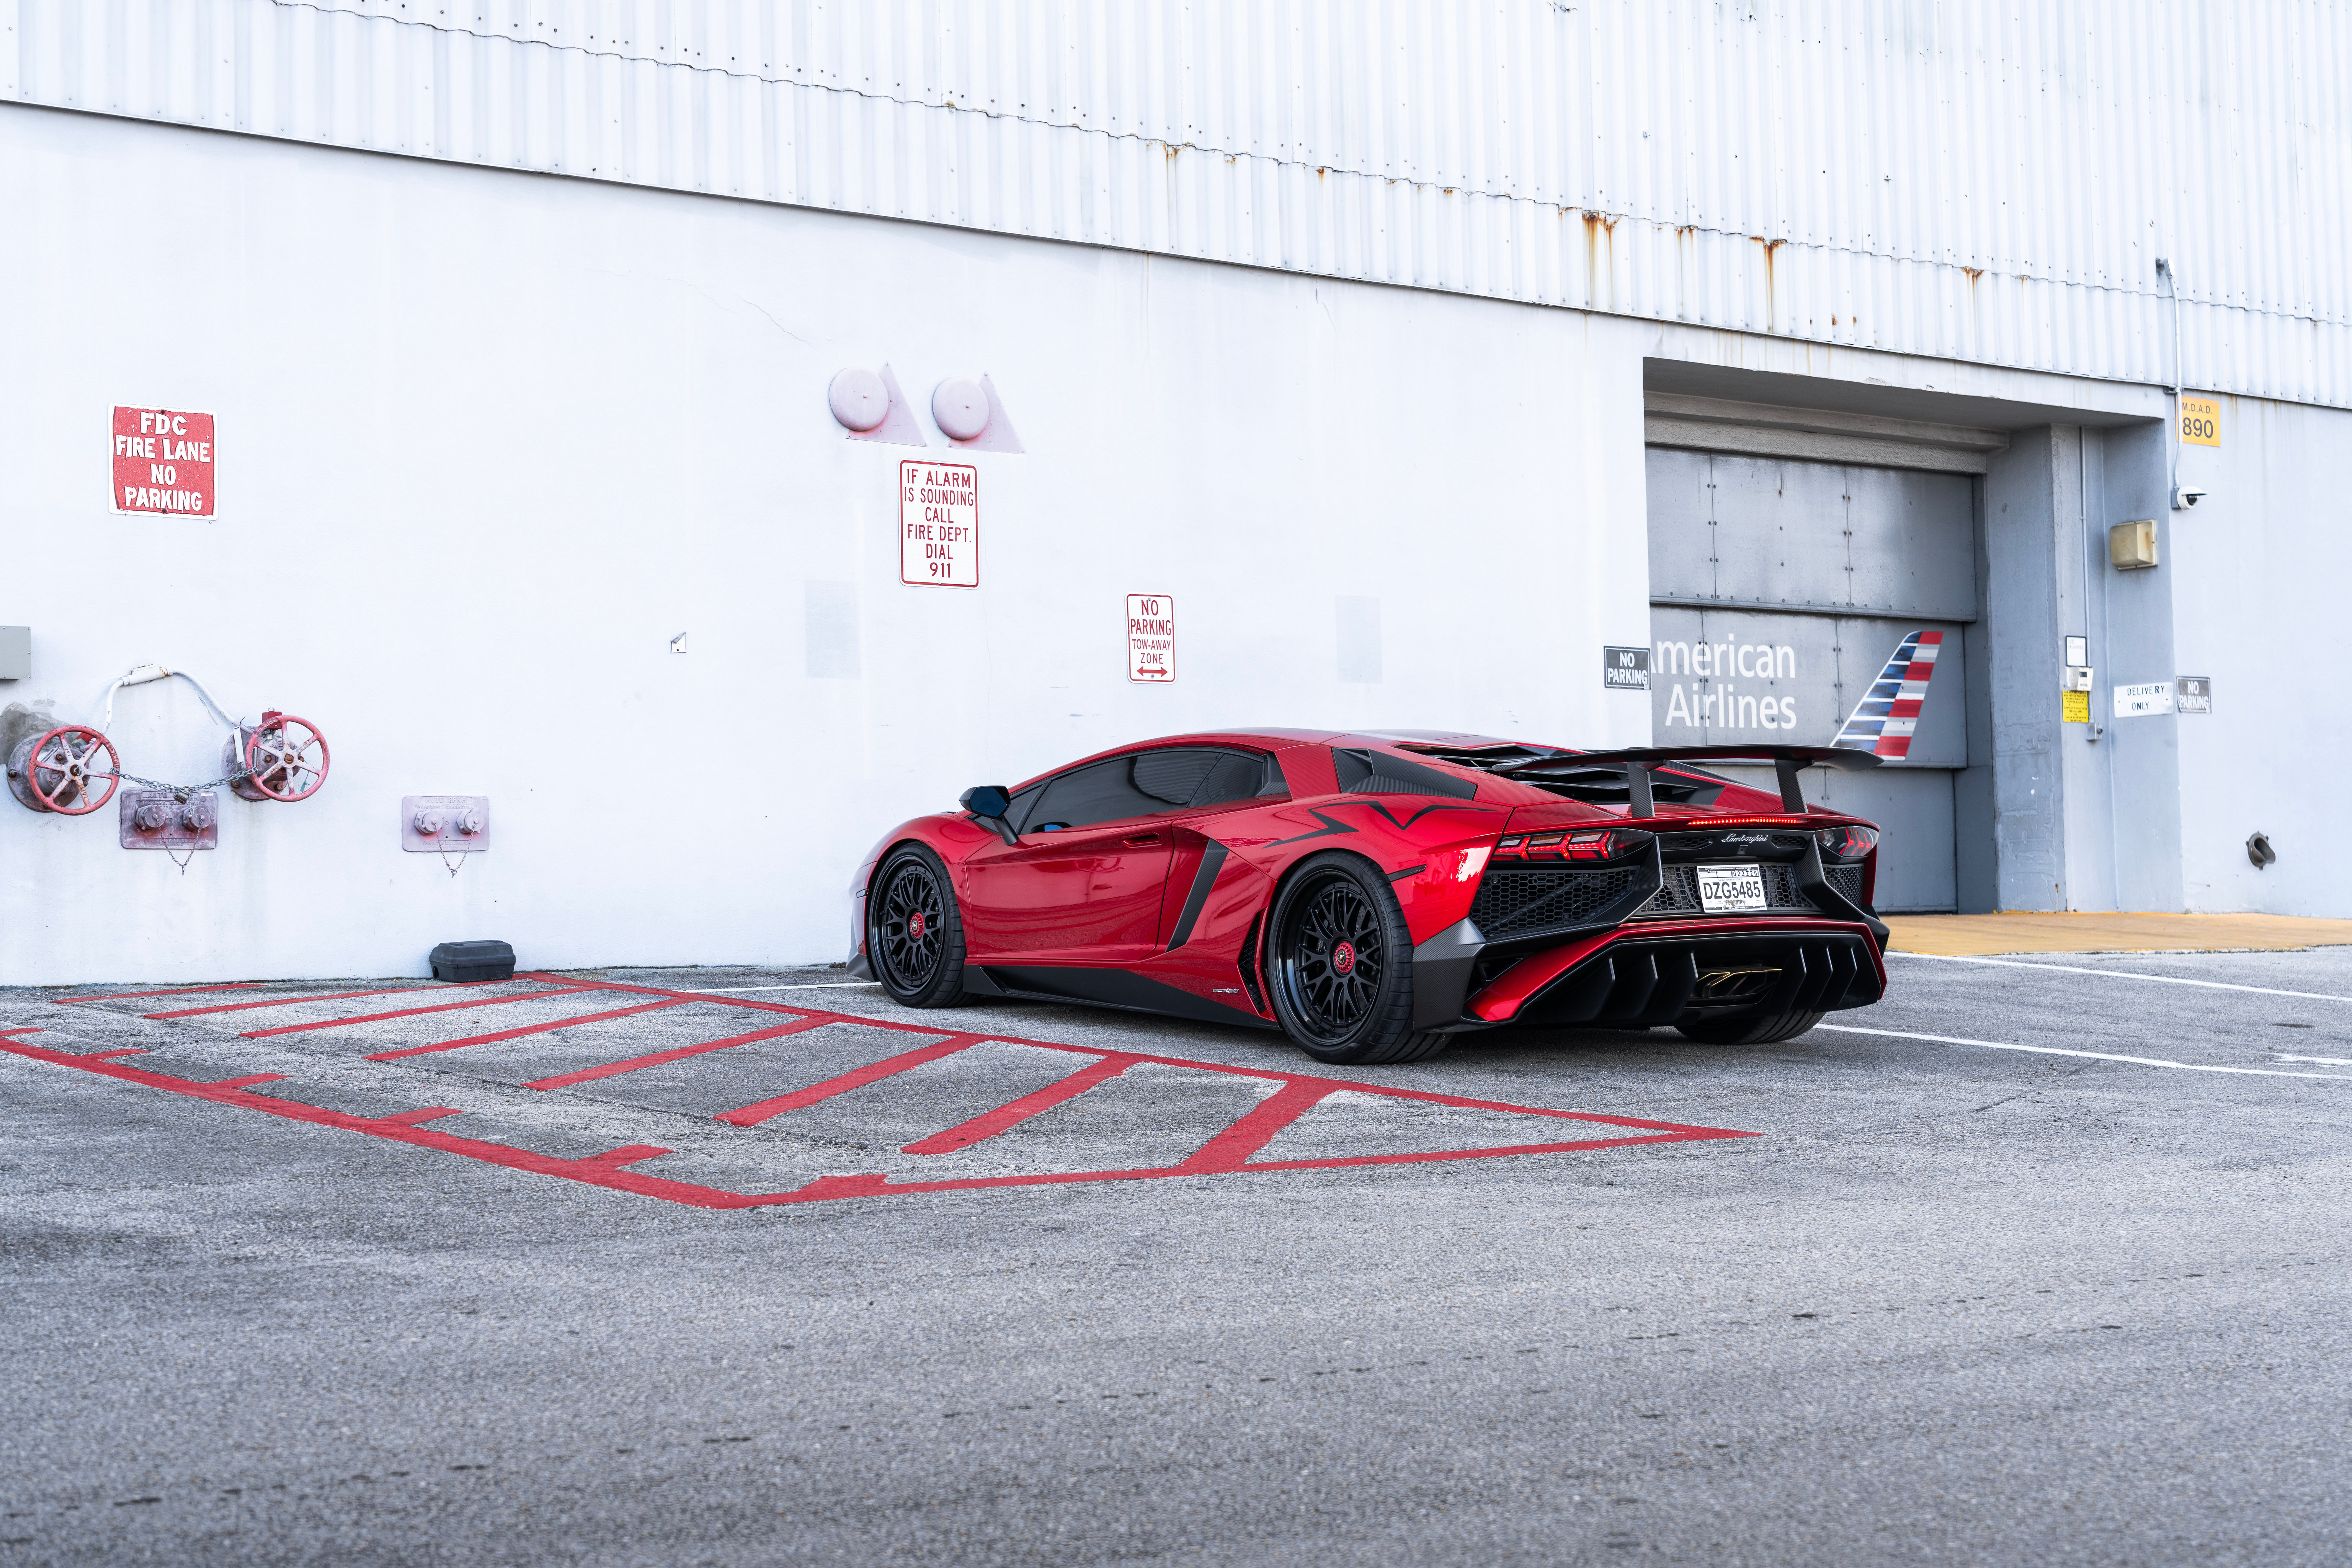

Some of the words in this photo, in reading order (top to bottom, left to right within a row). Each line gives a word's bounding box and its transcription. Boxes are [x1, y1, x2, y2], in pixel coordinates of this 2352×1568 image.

[2182, 402, 2213, 414] M.D.A.D.
[140, 411, 187, 436] FDC
[2183, 417, 2213, 438] 890
[116, 434, 155, 459] FIRE
[162, 438, 210, 462] LANE
[151, 464, 176, 485] NO
[907, 469, 918, 483] IF
[926, 470, 970, 488] ALARM
[125, 486, 202, 512] PARKING
[905, 487, 913, 501] IS
[920, 488, 973, 506] SOUNDING
[925, 507, 954, 523] CALL
[908, 524, 933, 540] FIRE
[940, 526, 971, 542] DEPT.
[926, 544, 954, 559] DIAL
[930, 562, 950, 578] 911
[1141, 599, 1158, 616] NO
[1131, 619, 1171, 635] PARKING
[1132, 639, 1171, 650] TOW-AWAY
[1141, 653, 1163, 664] ZONE
[1620, 652, 1635, 667] NO
[1651, 633, 1795, 678] merican
[1607, 668, 1648, 684] PARKING
[2127, 685, 2164, 695] DELIVERY
[2187, 681, 2199, 694] NO
[1665, 683, 1797, 729] Airlines
[2132, 702, 2149, 710] ONLY
[2179, 695, 2208, 709] PARKING
[1721, 833, 1769, 843] Lamborghini
[1367, 882, 1383, 908] 355/25
[1703, 881, 1761, 899] DZG5485
